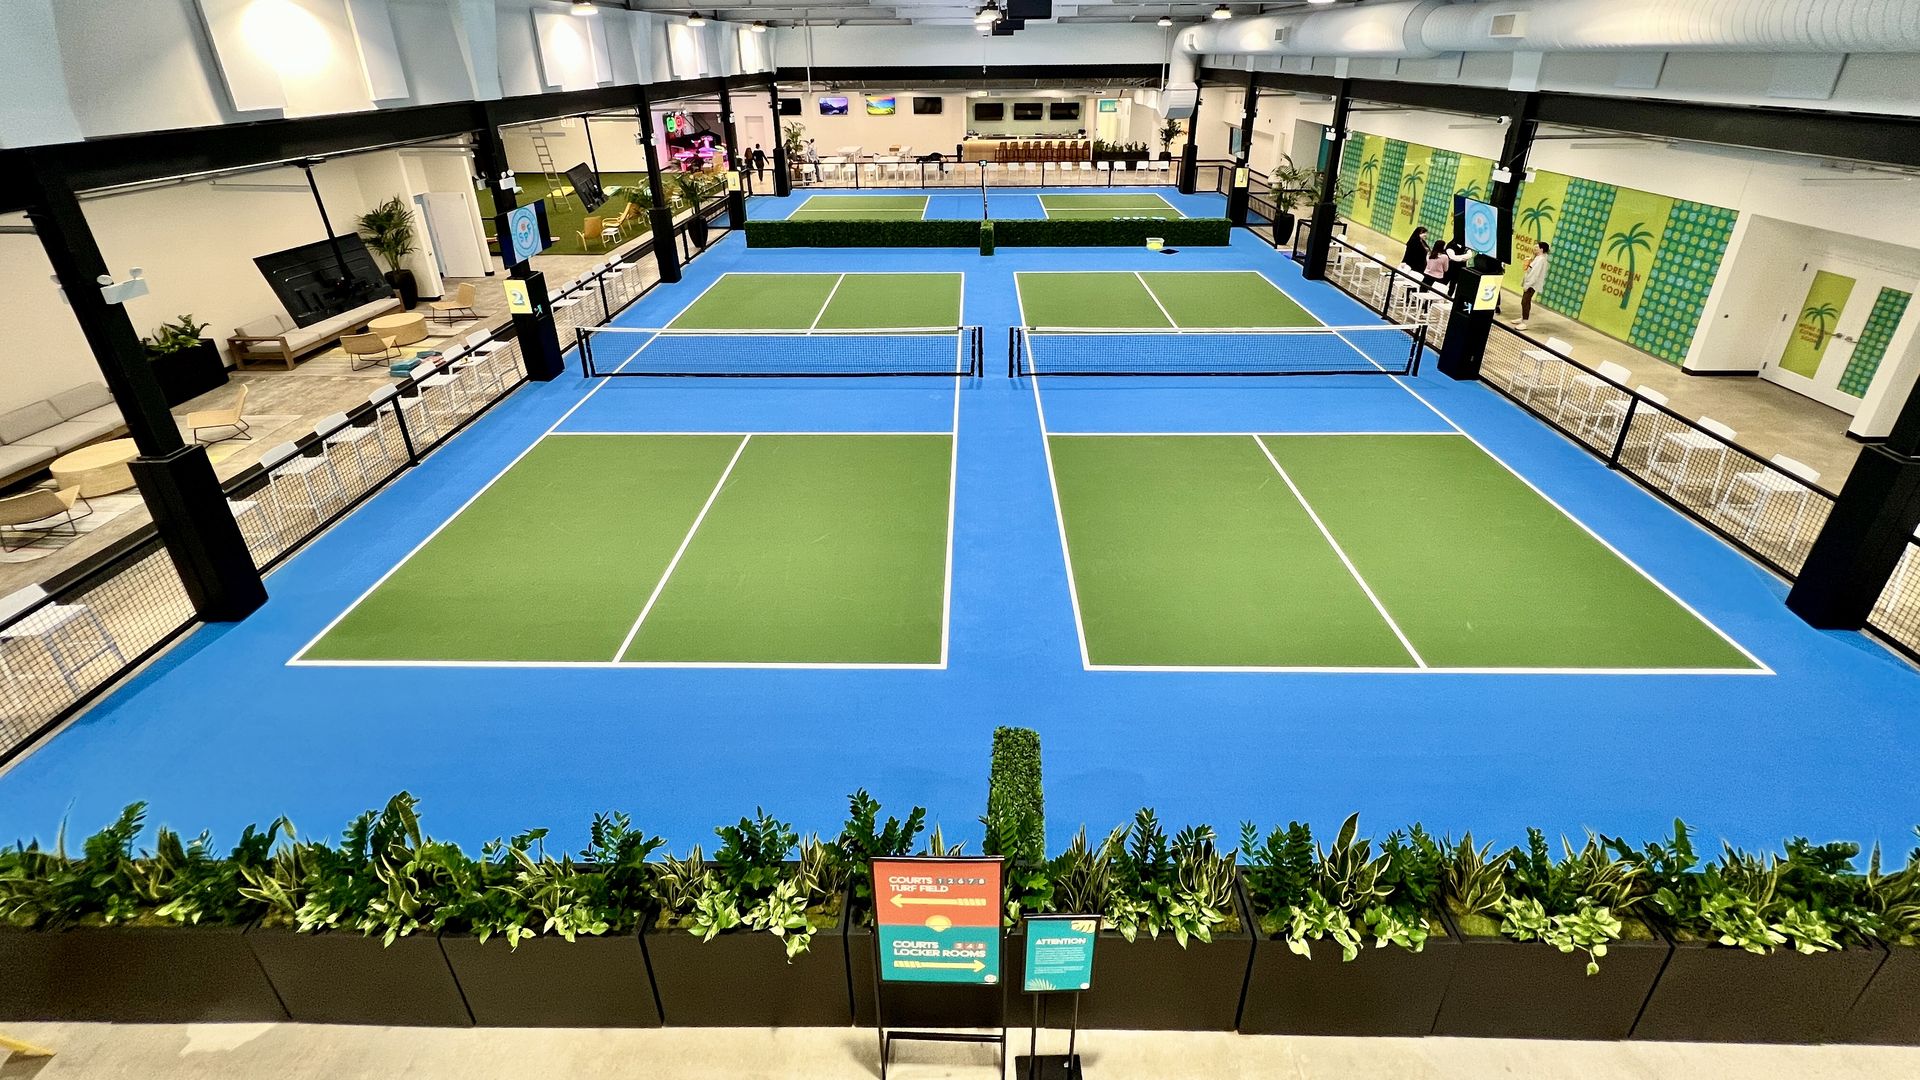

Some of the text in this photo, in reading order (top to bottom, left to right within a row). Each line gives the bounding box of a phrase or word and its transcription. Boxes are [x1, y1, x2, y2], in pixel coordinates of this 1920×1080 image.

[1515, 233, 1532, 244] MORE
[1600, 262, 1624, 275] MORE
[511, 289, 525, 306] 2
[1481, 285, 1496, 302] 3
[889, 876, 933, 885] COURTS
[890, 884, 949, 893] TURF FIELD
[892, 940, 939, 949] COURTS
[1035, 937, 1087, 945] ATTENTION
[893, 948, 986, 958] LOCKER ROOMS
